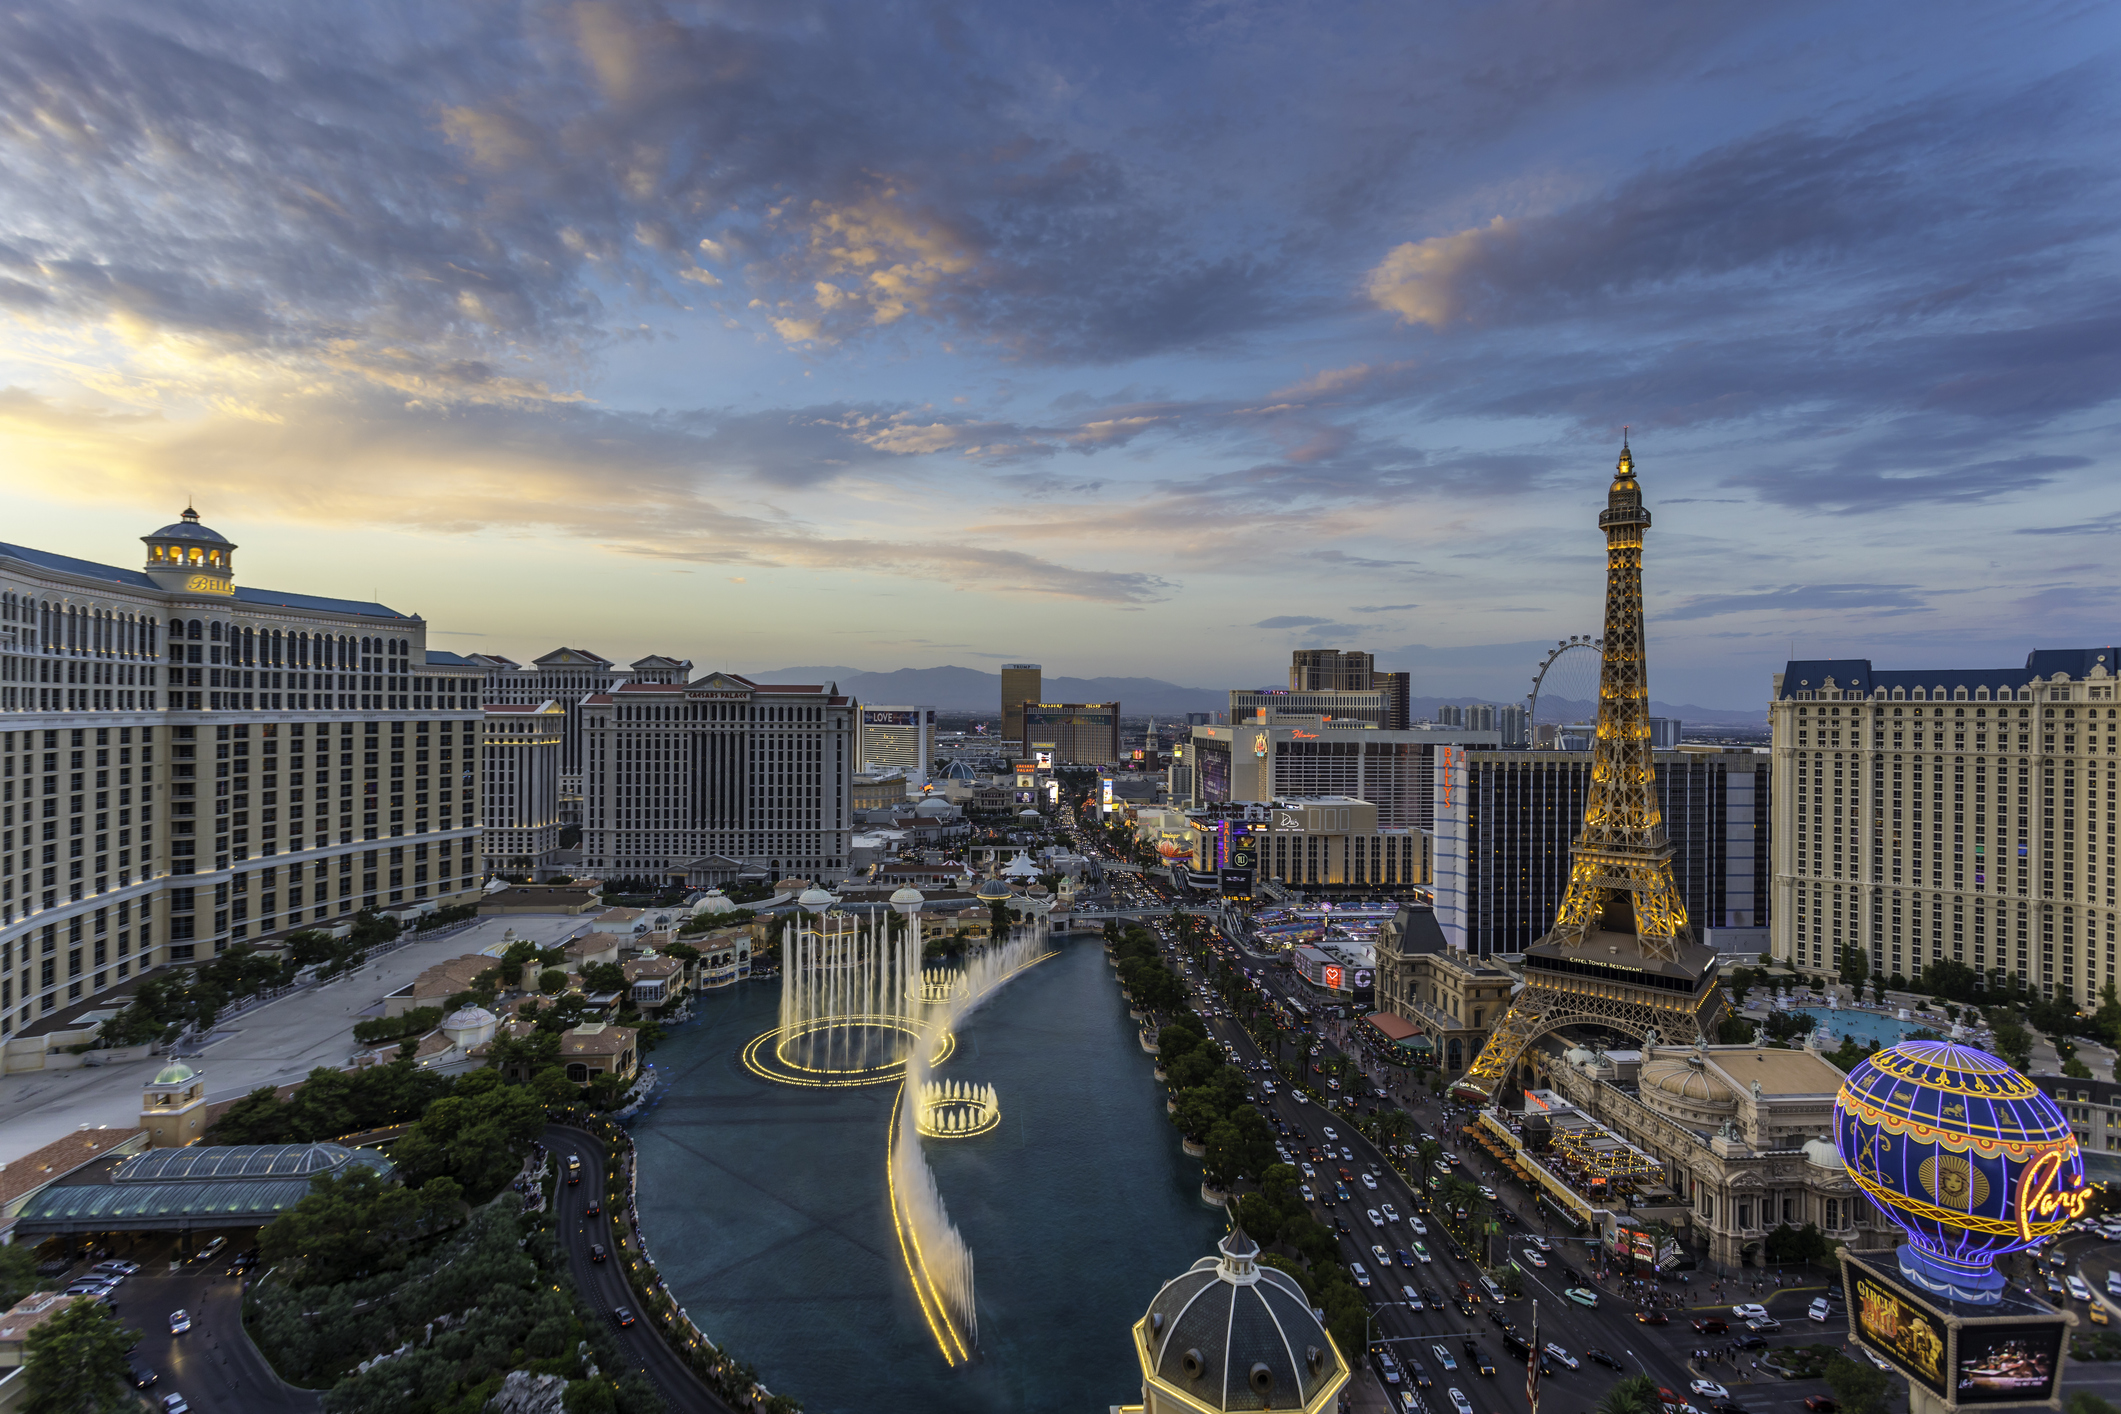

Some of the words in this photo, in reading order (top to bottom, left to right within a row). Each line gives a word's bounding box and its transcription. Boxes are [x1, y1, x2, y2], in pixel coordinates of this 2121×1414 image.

[873, 713, 893, 722] LOVE
[1291, 729, 1320, 740] Flamingo
[1443, 747, 1453, 808] BALLYS
[1569, 957, 1587, 965] EIFFEL
[1588, 959, 1608, 968] TOWER
[1609, 963, 1643, 973] RESTAURANT
[1354, 969, 1376, 988] C
[2018, 1150, 2093, 1241] Paris
[1857, 1280, 1898, 1317] CIRCUS
